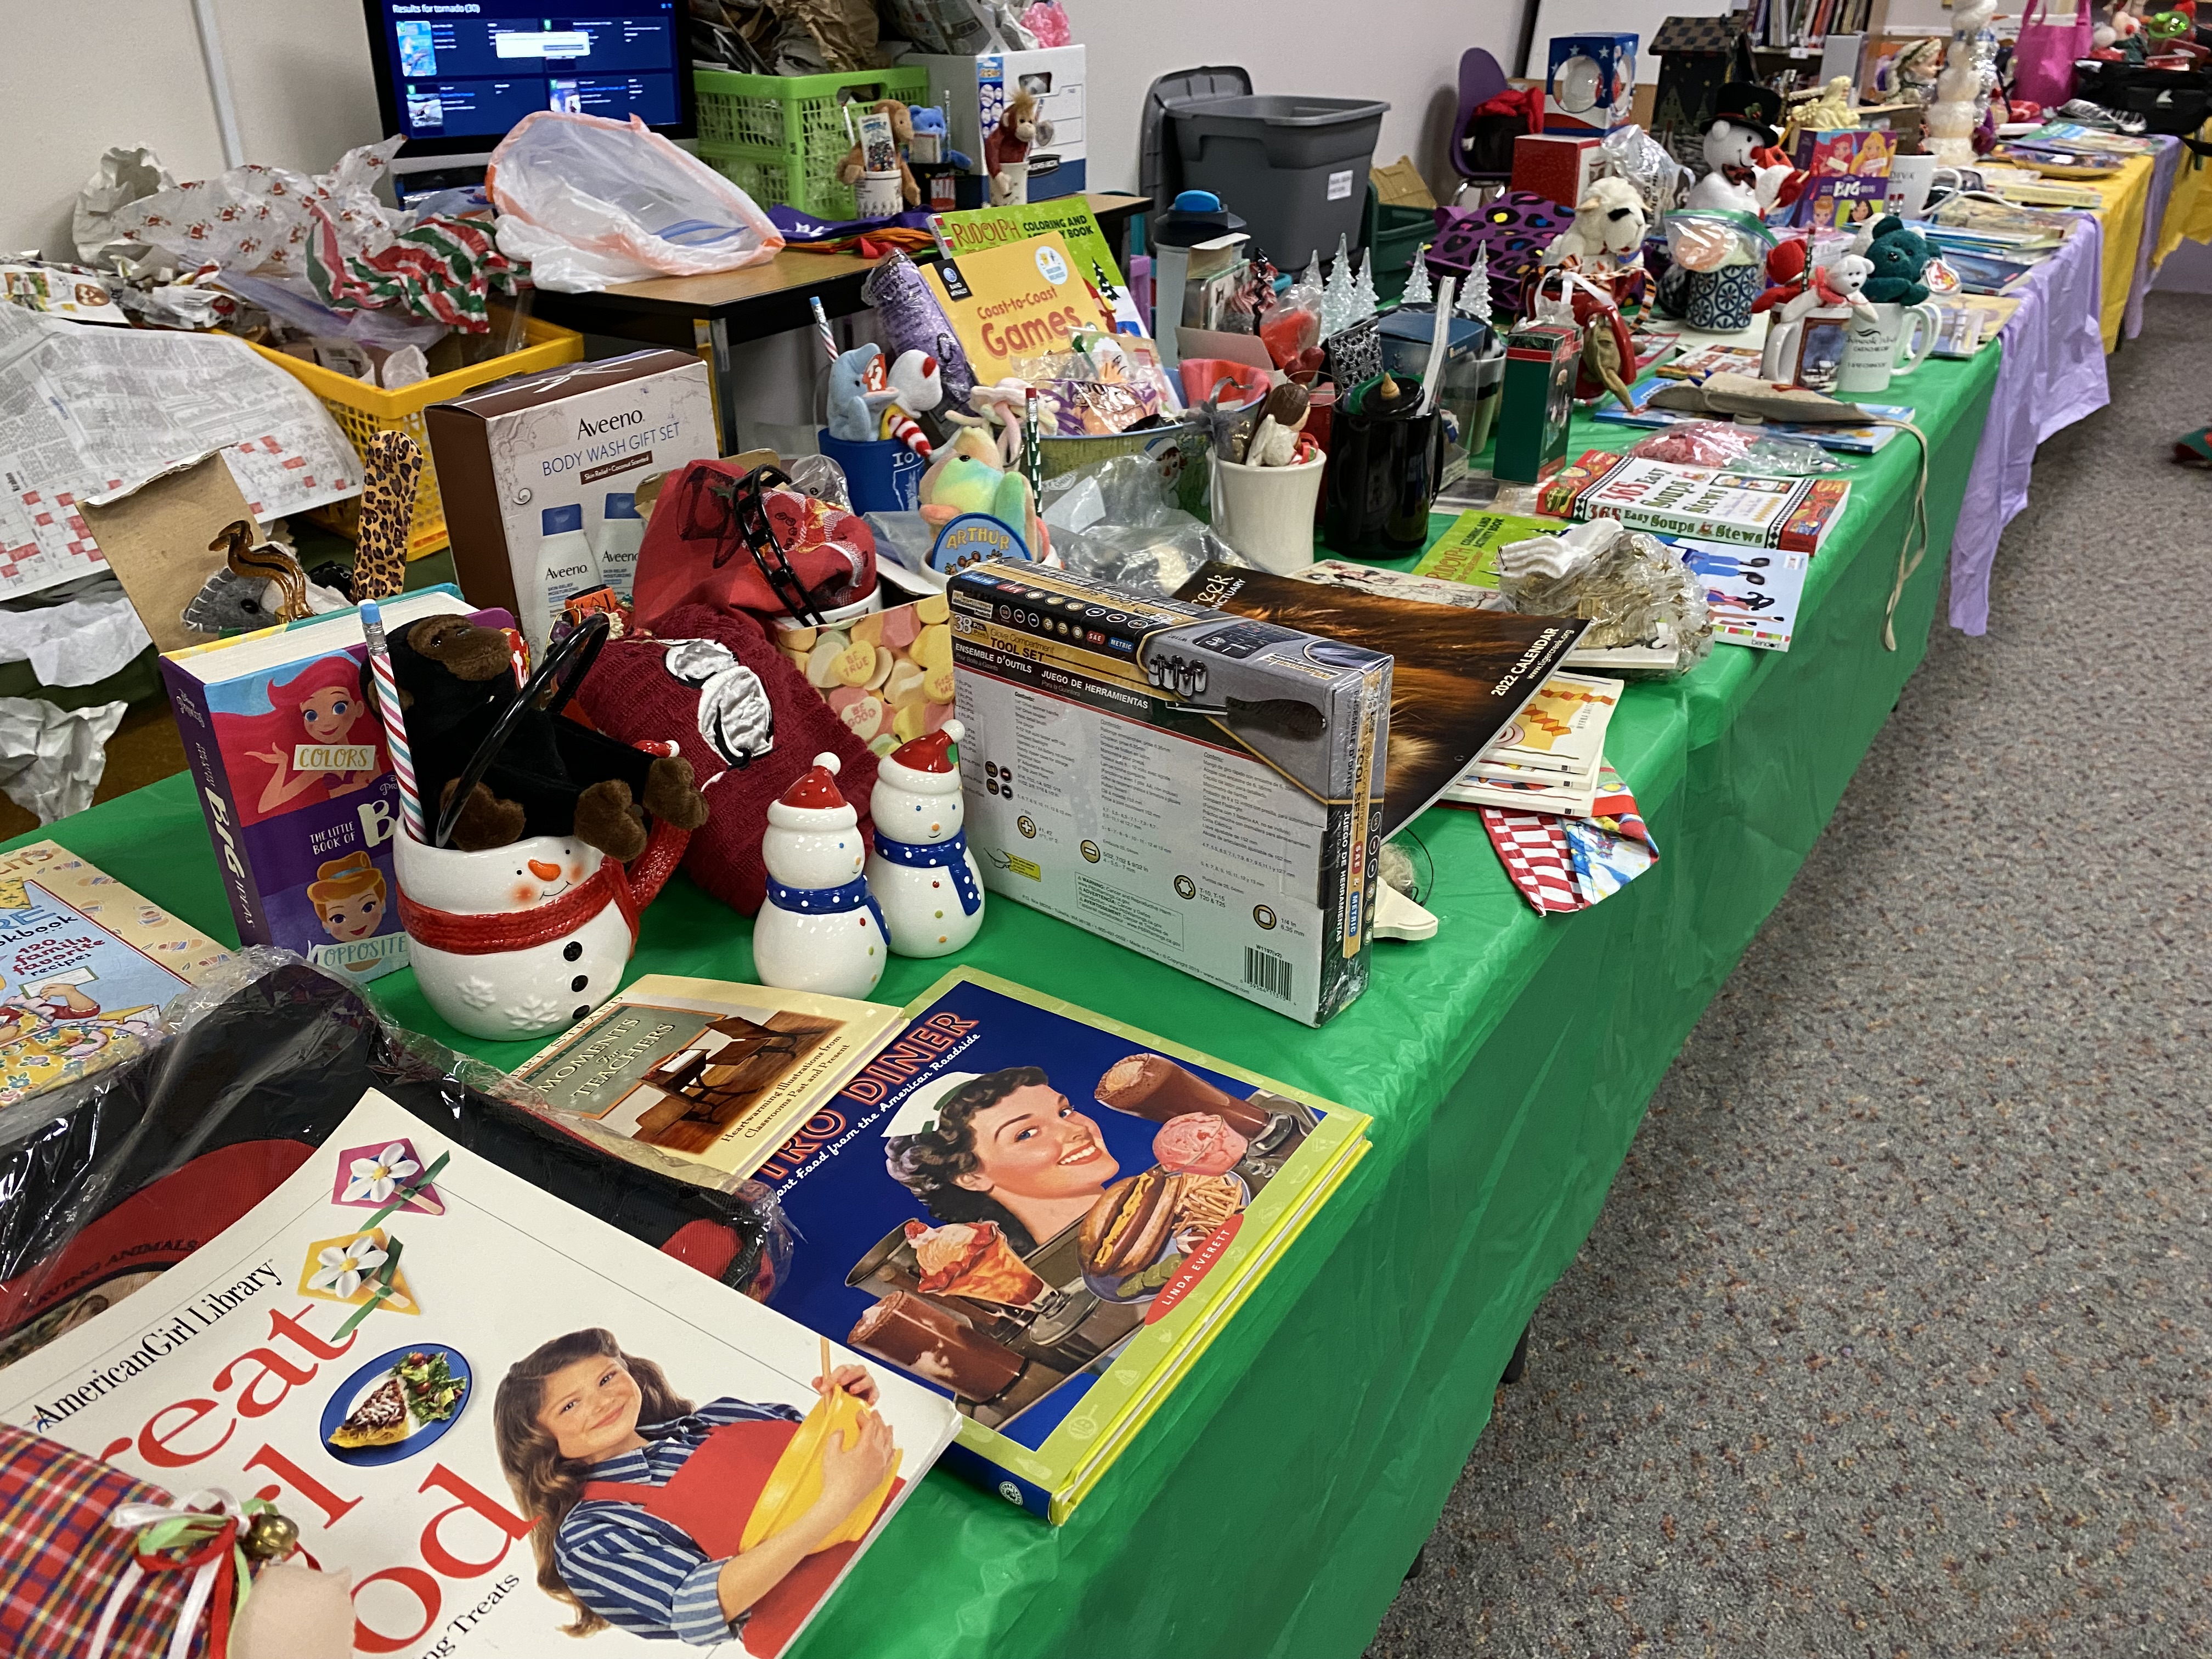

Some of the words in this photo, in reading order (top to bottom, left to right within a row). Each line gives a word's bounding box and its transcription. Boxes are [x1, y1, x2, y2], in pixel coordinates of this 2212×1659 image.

[393, 4, 421, 13] Results
[421, 4, 433, 13] for
[433, 4, 465, 13] tornado
[1833, 180, 1861, 198] BIG
[951, 218, 1022, 247] RUDOLPH
[1023, 218, 1065, 232] COLORING
[1068, 215, 1087, 227] AND
[1067, 225, 1094, 238] BOOK
[977, 286, 1058, 320] Coast-to-Coast
[981, 306, 1082, 358] Games
[577, 410, 644, 441] Aveeno
[542, 451, 583, 476] BODY
[586, 439, 626, 462] WASH
[629, 429, 656, 450] GIFT
[659, 422, 680, 441] SET
[1598, 480, 1651, 503] 365
[1637, 467, 1672, 485] Easy
[1640, 479, 1696, 509] Soups
[1682, 488, 1729, 514] Stews
[946, 527, 1010, 550] ARTHUR
[1588, 504, 1622, 522] 365
[1624, 509, 1649, 523] Easy
[1650, 514, 1696, 533] Soups
[1715, 524, 1764, 544] Stews
[545, 564, 589, 581] Aveeno
[1425, 546, 1474, 581] RUDOLPH
[1191, 574, 1234, 604] eek
[1211, 578, 1246, 610] NCTUARY
[953, 614, 973, 635] 38
[973, 622, 985, 631] Pcs.
[990, 628, 1009, 641] Glove
[1009, 634, 1056, 654] Compartment
[990, 637, 1020, 656] TOOL
[1023, 647, 1046, 662] SET
[1088, 633, 1102, 642] SAE
[1110, 639, 1133, 651] METRIC
[1526, 629, 1575, 680] www.tigercreek.org
[1751, 639, 1781, 649] bendon
[843, 656, 870, 678] TRUE
[845, 651, 859, 664] BE
[955, 644, 995, 663] ENSEMBLE
[996, 655, 1032, 674] D'OUTILS
[1491, 674, 1519, 697] 2022
[1510, 627, 1559, 675] CALENDAR
[1041, 670, 1068, 685] JUEGO
[1071, 679, 1082, 689] DE
[1085, 683, 1149, 709] HERRAMIENTAS
[847, 708, 877, 728] GOOD
[300, 747, 368, 768] COLORS
[1352, 792, 1362, 823] SET
[309, 832, 328, 845] THE
[327, 821, 356, 840] LITTLE
[313, 837, 341, 856] BOOK
[343, 832, 356, 844] OF
[1341, 811, 1350, 847] JUEGO
[204, 787, 245, 878] BIG
[234, 879, 256, 929] IDEAS
[1340, 850, 1347, 868] DE
[1353, 844, 1362, 869] SAE
[1353, 878, 1360, 887] &
[1336, 870, 1346, 943] HERRAMIENTAS
[1349, 894, 1358, 933] METRIC
[1280, 924, 1294, 934] 6.35
[12, 940, 106, 976] favorite
[14, 936, 92, 966] family
[18, 939, 57, 953] 120
[30, 953, 92, 977] recipes
[510, 1053, 546, 1077] ERT
[550, 996, 623, 1048] STRAND
[537, 1018, 641, 1093] MOMENTS
[569, 1023, 676, 1098] TEACHERS
[838, 1011, 981, 1107] DINER
[720, 1091, 783, 1142] Heartwarming
[776, 1051, 825, 1091] Illustrations
[819, 1036, 843, 1052] from
[744, 1097, 792, 1138] Classrooms
[786, 1082, 809, 1098] Past
[808, 1068, 823, 1083] and
[819, 1043, 850, 1069] Present
[796, 1150, 830, 1180] Food
[826, 1127, 860, 1157] from
[857, 1111, 880, 1132] the
[879, 1070, 933, 1113] American
[929, 1032, 981, 1074] Roadside
[106, 1239, 199, 1266] ANIMALS
[1160, 1273, 1194, 1306] LINDA
[1191, 1229, 1231, 1272] EVERETT
[34, 1316, 201, 1430] AmericanGirl
[193, 1260, 284, 1327] Library
[446, 1573, 520, 1635] Treats
